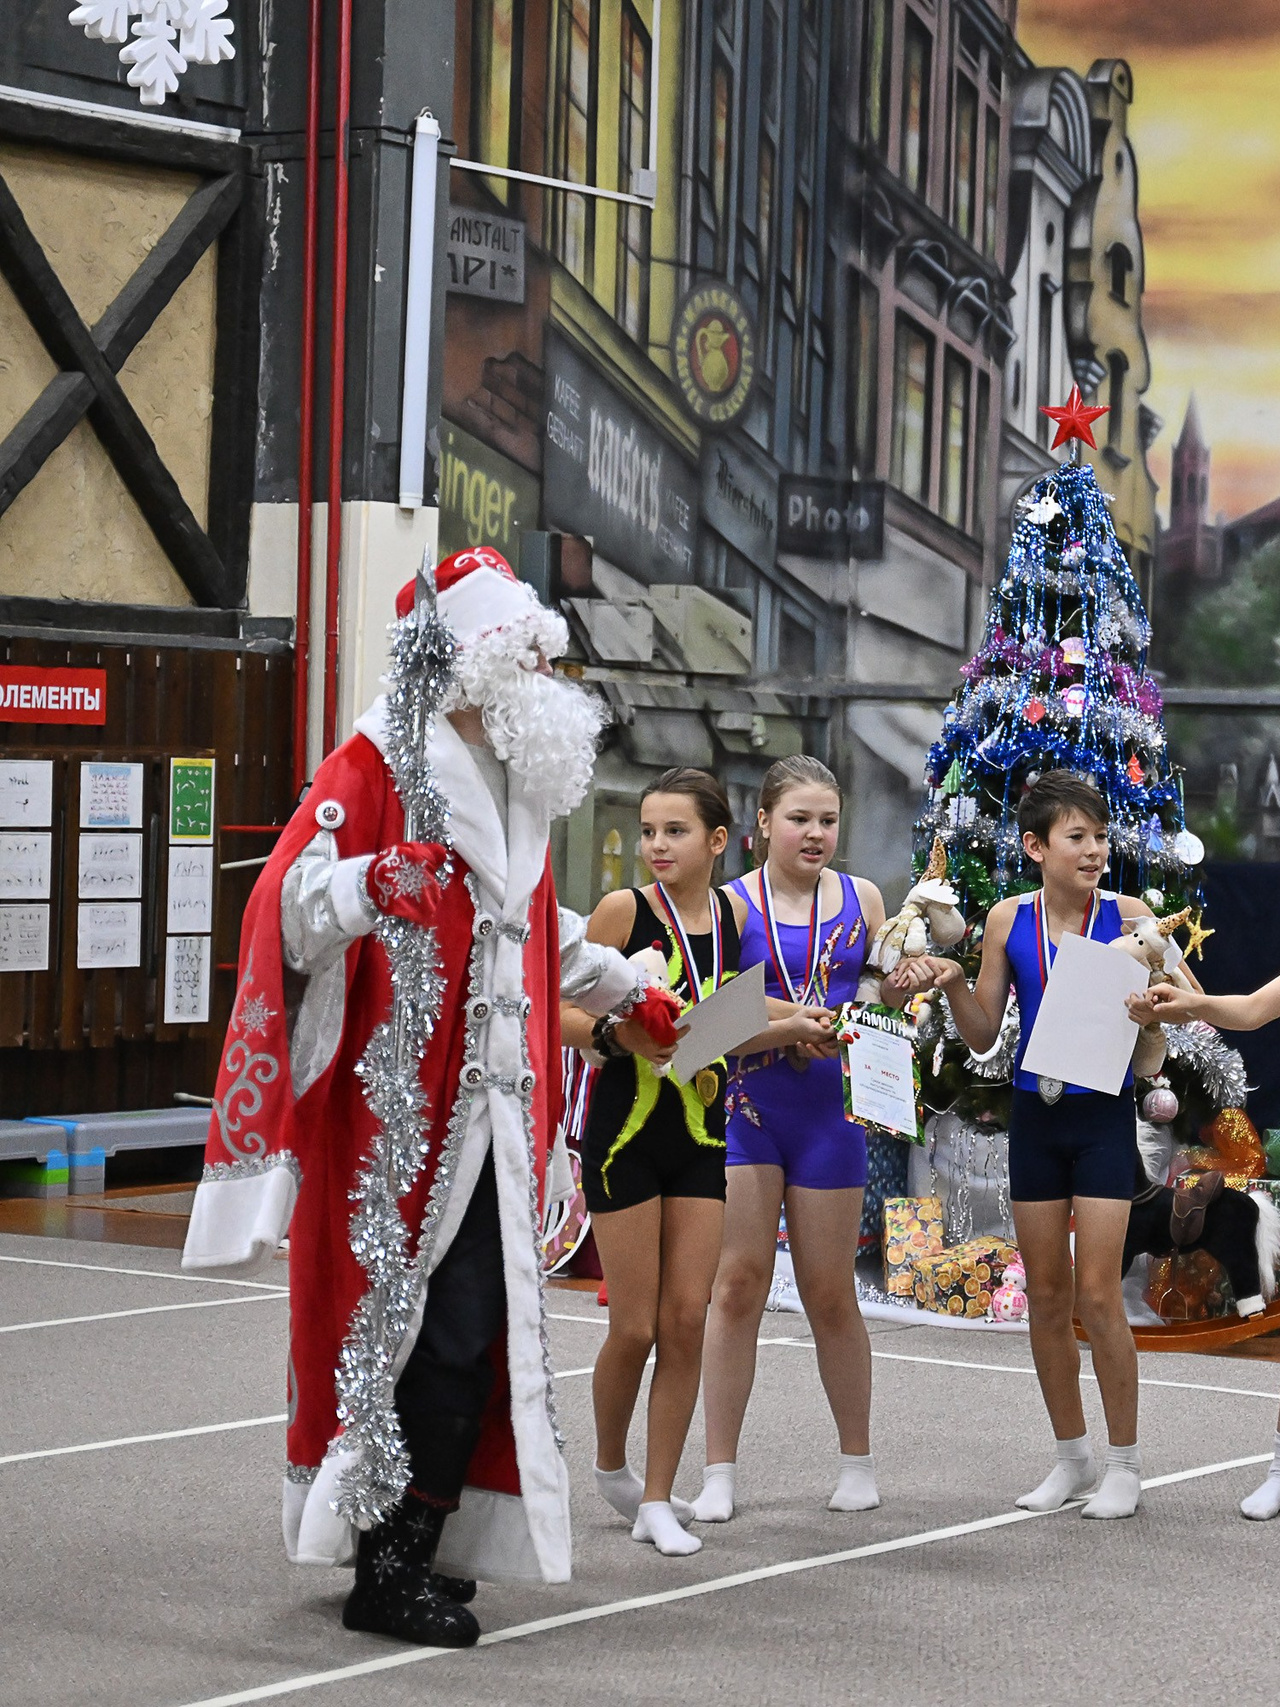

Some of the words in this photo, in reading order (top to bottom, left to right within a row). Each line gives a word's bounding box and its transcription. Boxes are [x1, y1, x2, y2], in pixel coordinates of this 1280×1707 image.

[450, 217, 520, 252] ANSTALT
[439, 432, 516, 547] inger
[788, 493, 870, 533] Photo
[840, 1001, 907, 1038] ГРАМОТА
[881, 1070, 900, 1081] МЕСТО
